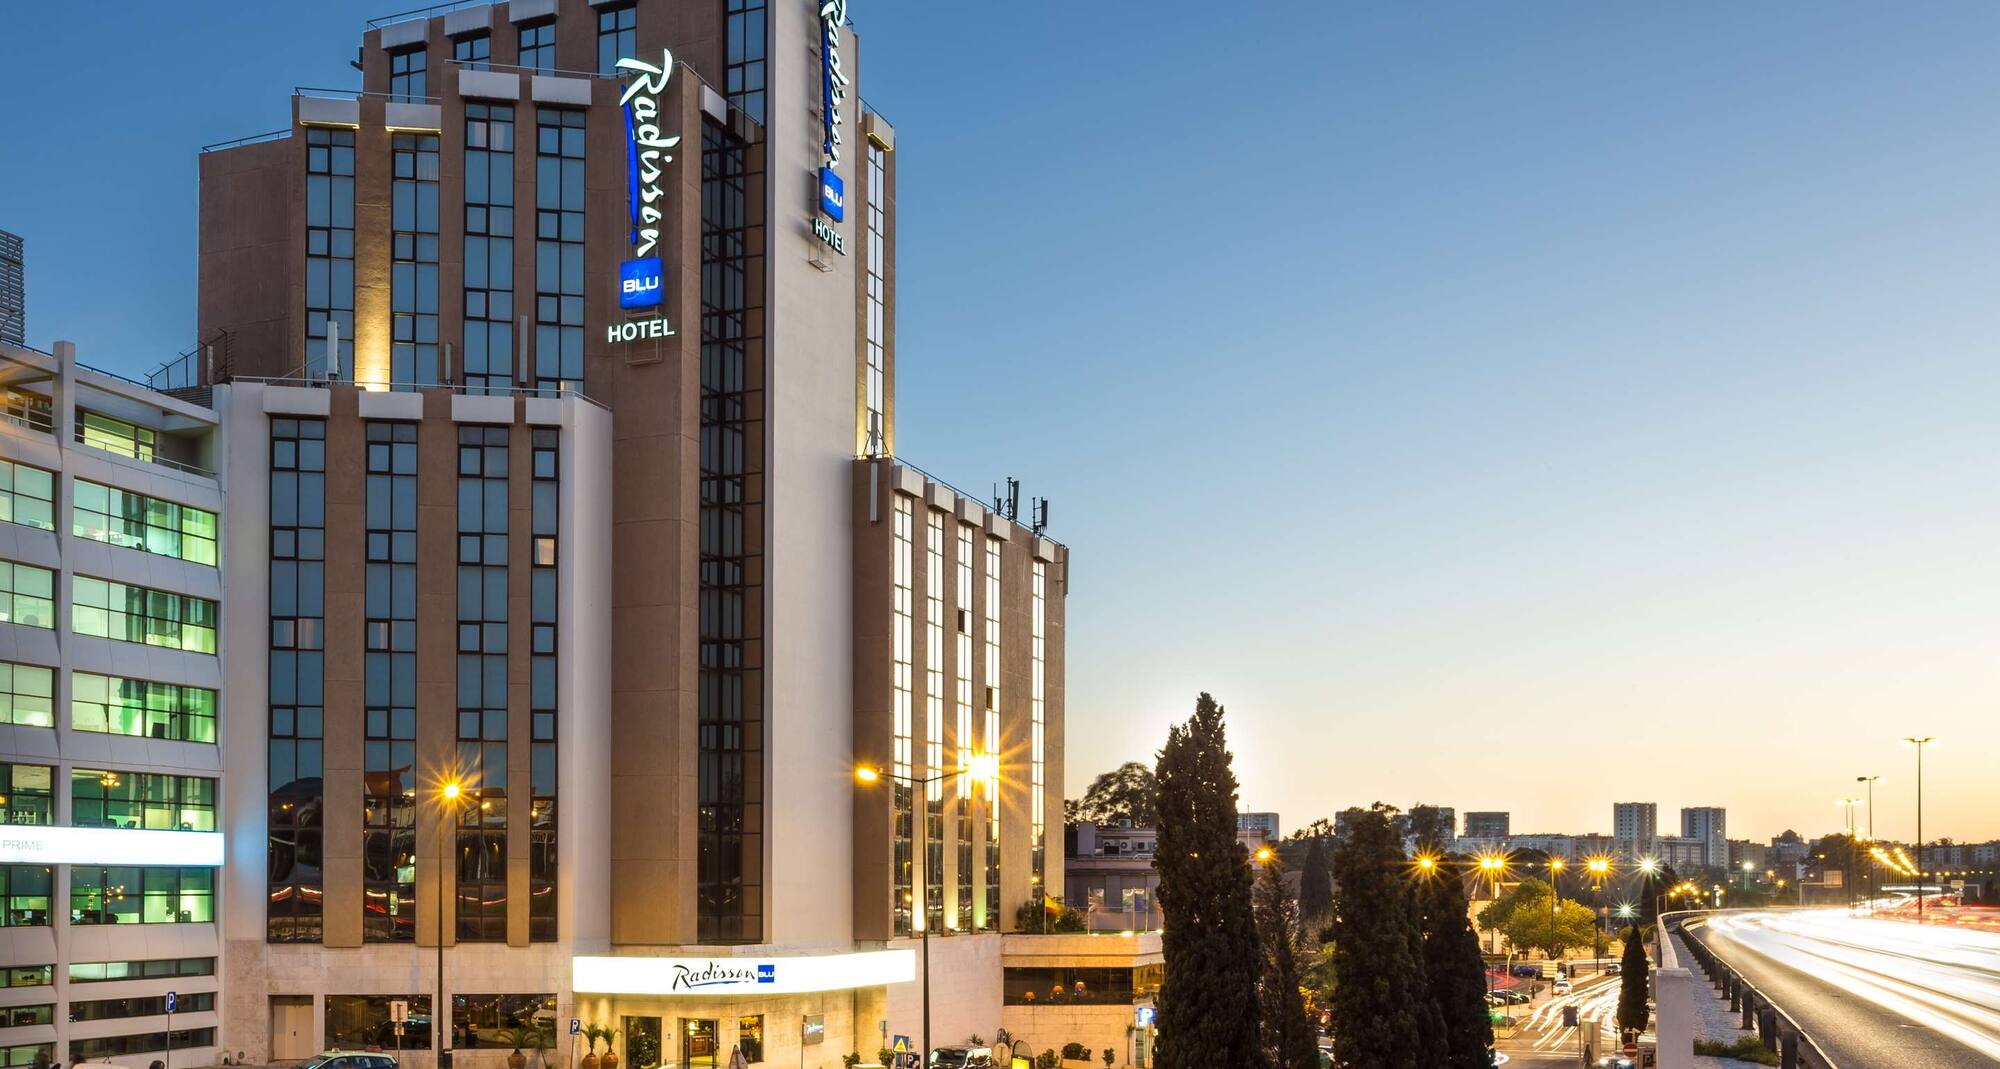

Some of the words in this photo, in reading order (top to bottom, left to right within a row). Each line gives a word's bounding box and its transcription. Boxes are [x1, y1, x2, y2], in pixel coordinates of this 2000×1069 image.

[615, 48, 680, 257] Radisson
[824, 184, 843, 208] BLU
[814, 217, 847, 256] HOTEL
[622, 275, 659, 294] BLU
[608, 319, 675, 343] HOTEL
[2, 839, 44, 851] PRIME
[672, 961, 755, 991] Radisson
